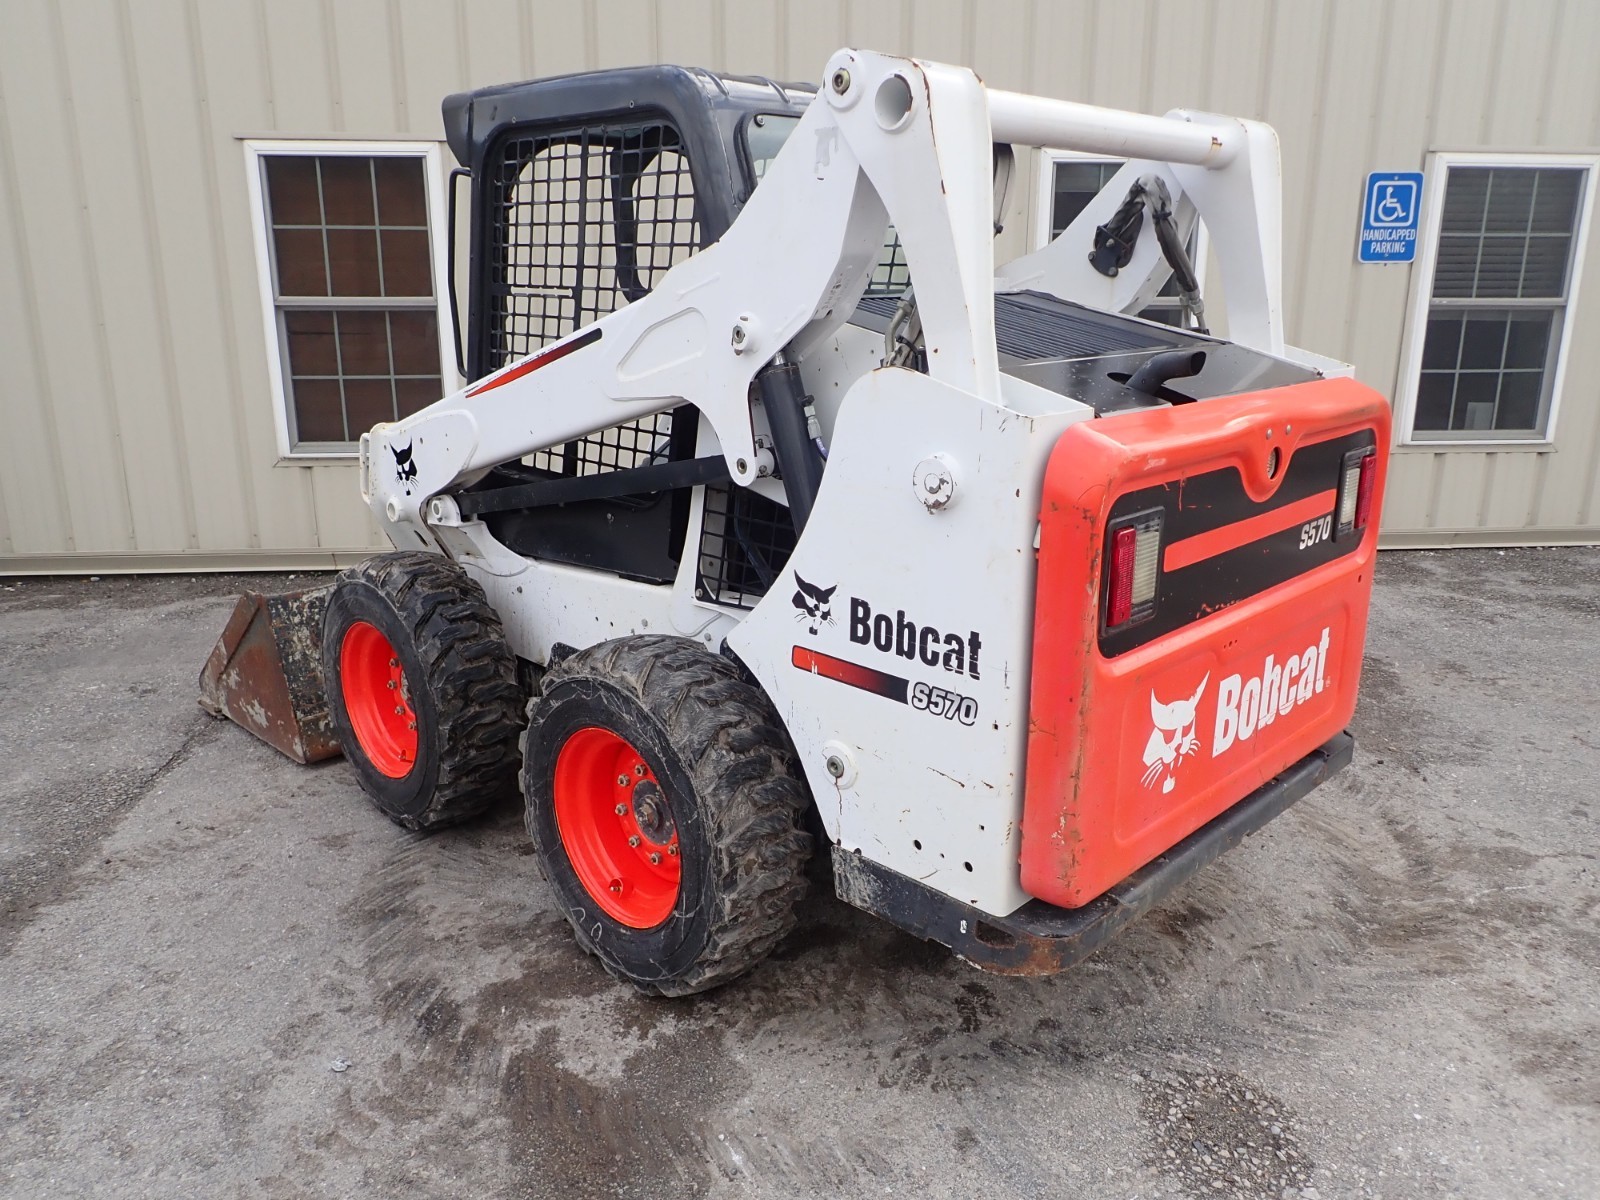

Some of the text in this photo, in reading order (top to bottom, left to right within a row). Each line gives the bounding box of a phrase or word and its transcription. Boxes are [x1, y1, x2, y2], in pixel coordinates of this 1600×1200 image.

[1363, 229, 1416, 241] HANDICAPPED
[1370, 241, 1406, 253] PARKING
[1299, 515, 1332, 550] S570
[849, 596, 982, 681] Bobcat
[911, 681, 979, 727] S570
[1211, 626, 1330, 759] Bobcat
